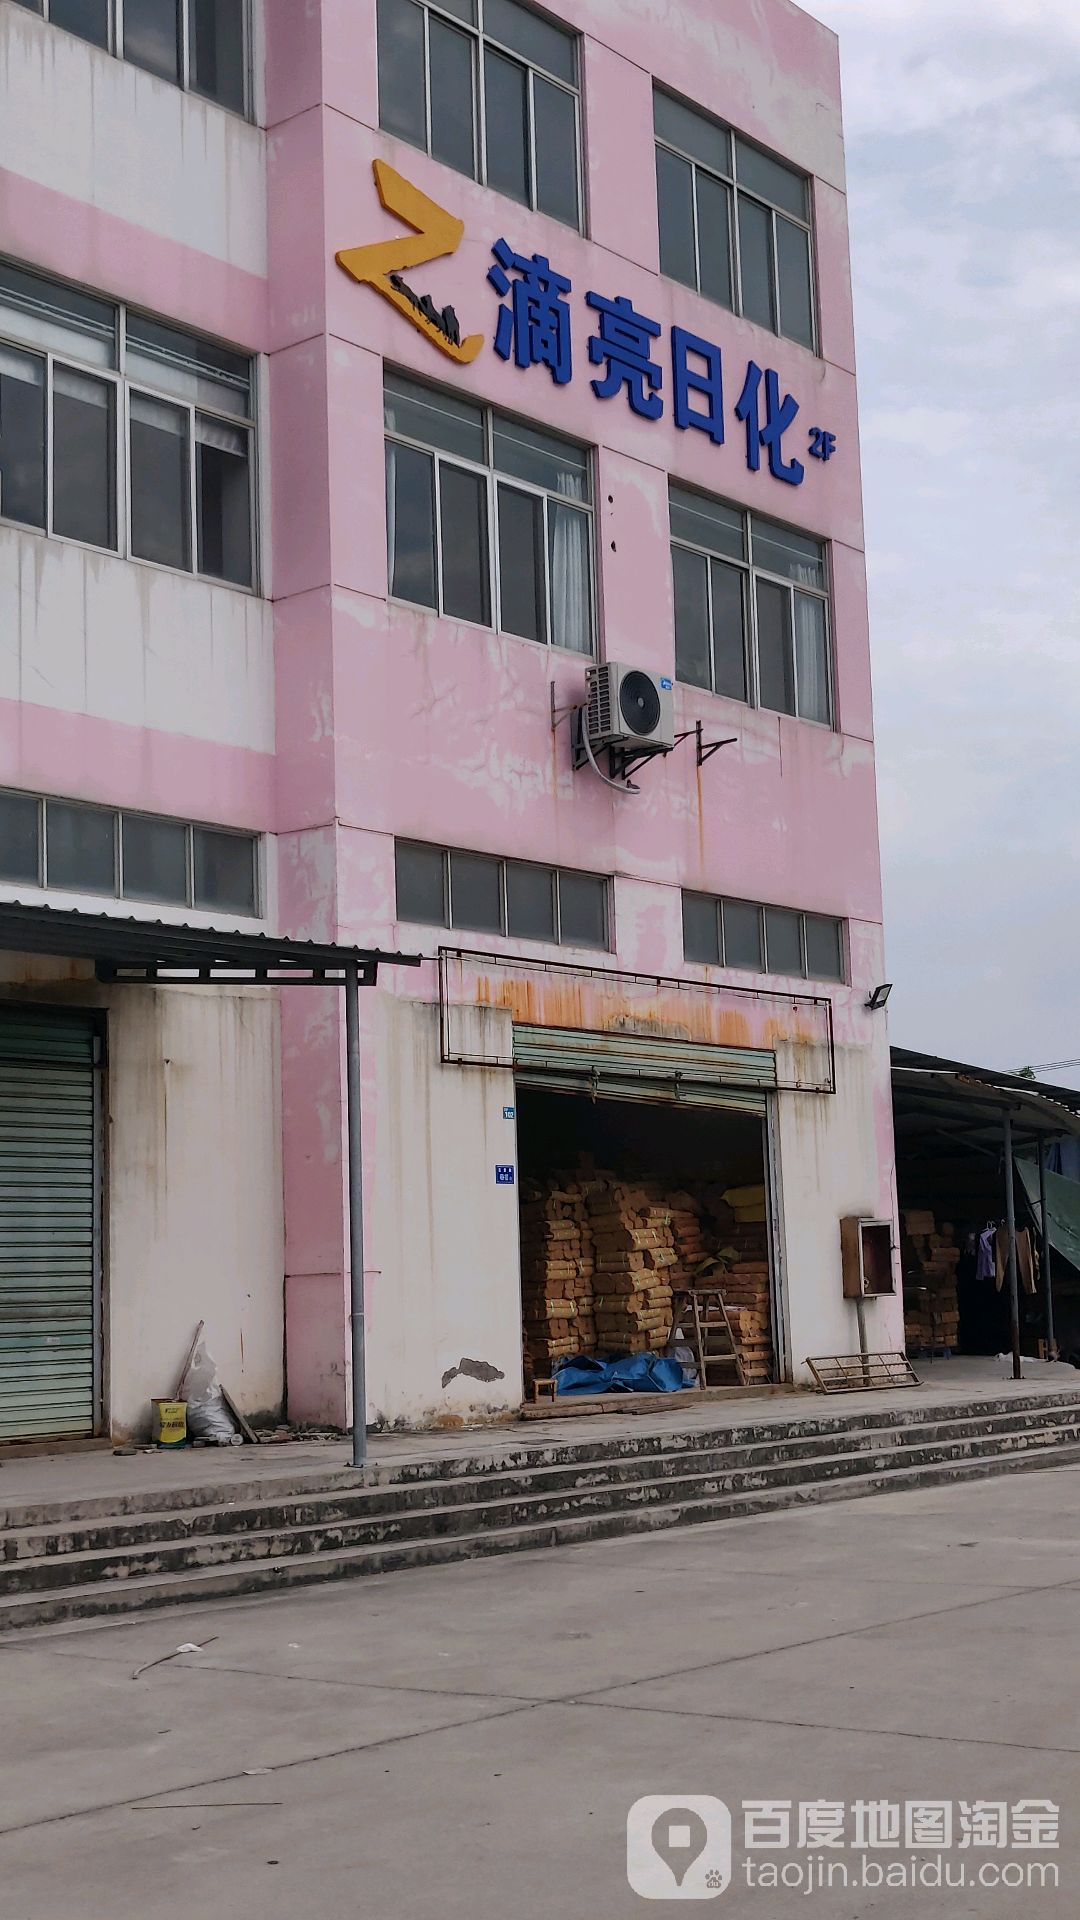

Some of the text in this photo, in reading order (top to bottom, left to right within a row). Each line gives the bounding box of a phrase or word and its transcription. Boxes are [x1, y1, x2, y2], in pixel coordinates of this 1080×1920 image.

[487, 237, 836, 486] 滴亮日化 2F
